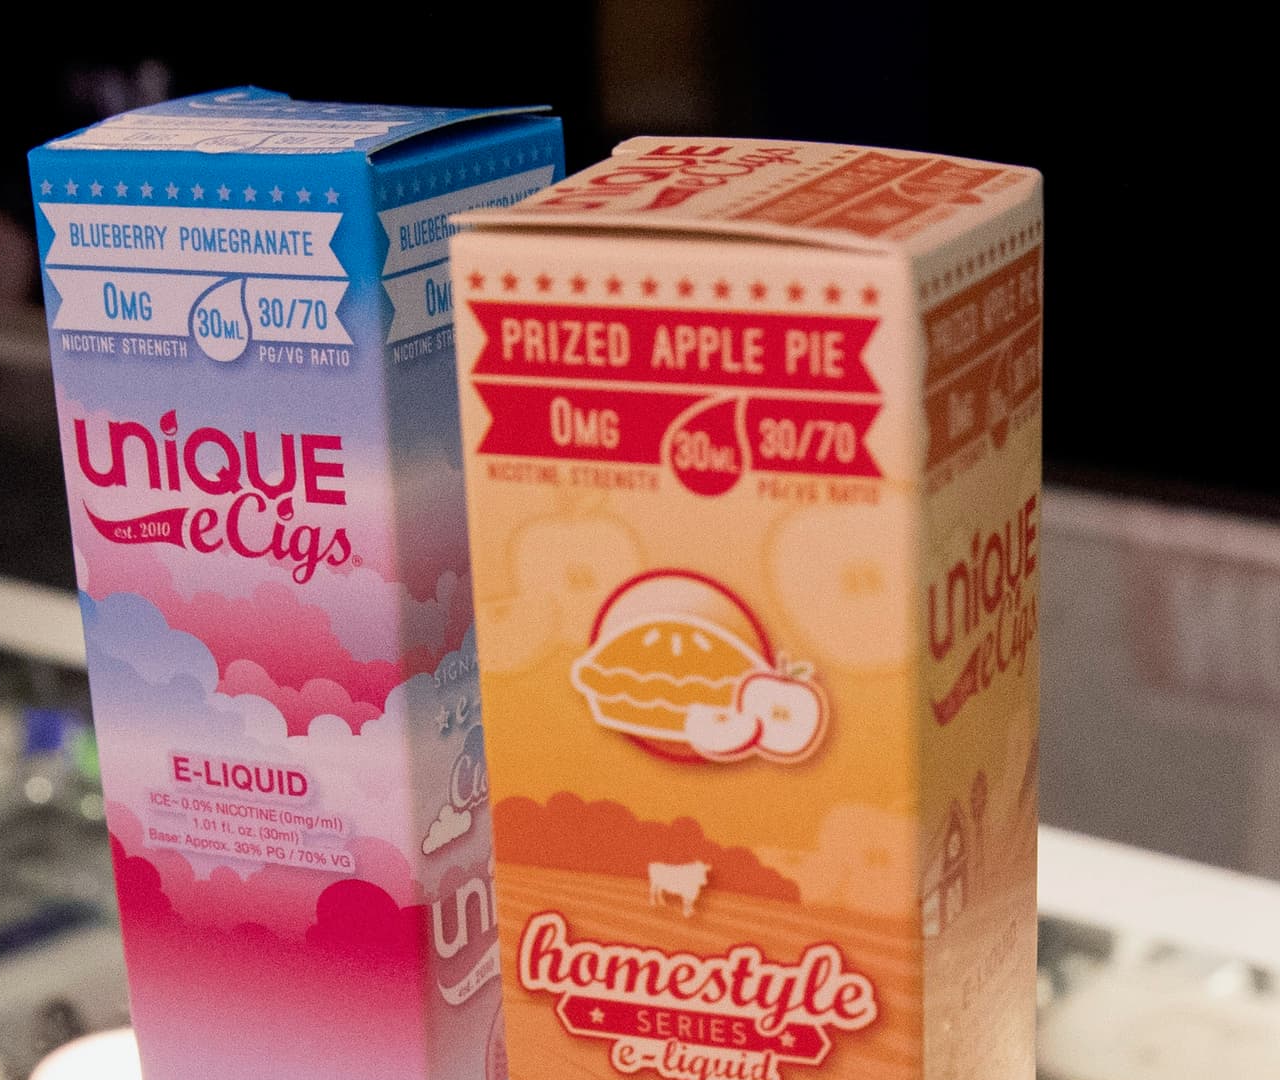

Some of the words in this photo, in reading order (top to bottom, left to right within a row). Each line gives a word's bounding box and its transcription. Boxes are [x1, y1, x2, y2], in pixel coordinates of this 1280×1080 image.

[70, 222, 167, 250] BLUEBERRY
[180, 227, 313, 256] POMEGRANATE
[259, 298, 328, 330] 30/70
[61, 334, 115, 354] NICOTINE
[123, 338, 188, 358] STRENGTH
[259, 346, 303, 365] PG/VG
[311, 348, 350, 366] RATIO
[393, 337, 432, 364] NICOTINE
[501, 318, 631, 367] PRIZED
[651, 325, 765, 375] APPLE
[785, 329, 844, 379] PIE
[758, 418, 856, 463] 30/70
[571, 467, 660, 491] STRENGTH
[826, 482, 881, 506] RATIO
[114, 523, 136, 538] est.
[140, 522, 170, 538] 2010
[190, 492, 352, 584] eCigs
[173, 756, 308, 797] E-LIQUID
[182, 799, 213, 814] 0.0%
[216, 804, 276, 822] NICOTINE
[280, 811, 343, 832] (0mg/ml)
[193, 818, 217, 832] 1.01
[238, 826, 256, 838] oz.
[260, 827, 299, 845] (30ml)
[235, 841, 263, 856] 30%
[267, 846, 285, 859] PG
[298, 850, 327, 865] 70%
[331, 854, 351, 868] VG
[528, 920, 871, 1032] homestyle
[636, 1008, 747, 1045] SERIES
